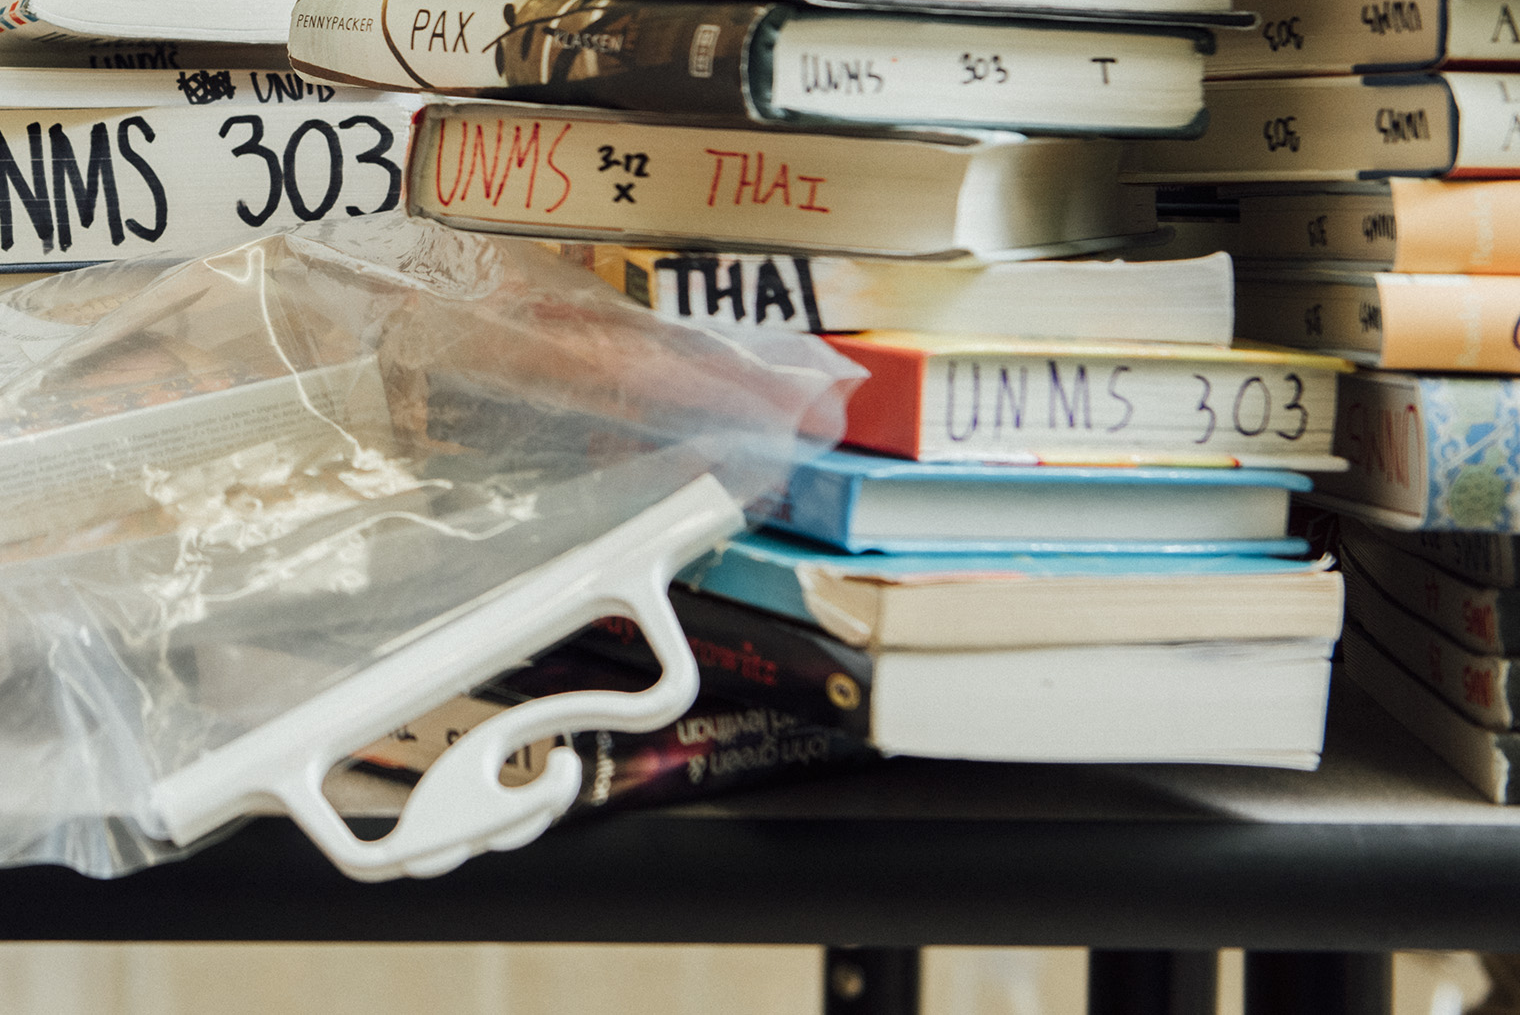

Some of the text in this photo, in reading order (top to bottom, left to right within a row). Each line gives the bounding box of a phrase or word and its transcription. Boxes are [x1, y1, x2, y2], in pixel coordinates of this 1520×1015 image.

[296, 7, 624, 55] PENNYPACKER PAX KLASSEN
[958, 51, 1009, 85] 303
[1088, 57, 1117, 85] T
[218, 113, 403, 228] 303
[436, 117, 573, 214] UNMS
[705, 146, 831, 215] THAI
[654, 255, 824, 334] THAI
[947, 357, 1311, 445] UNMS 303
